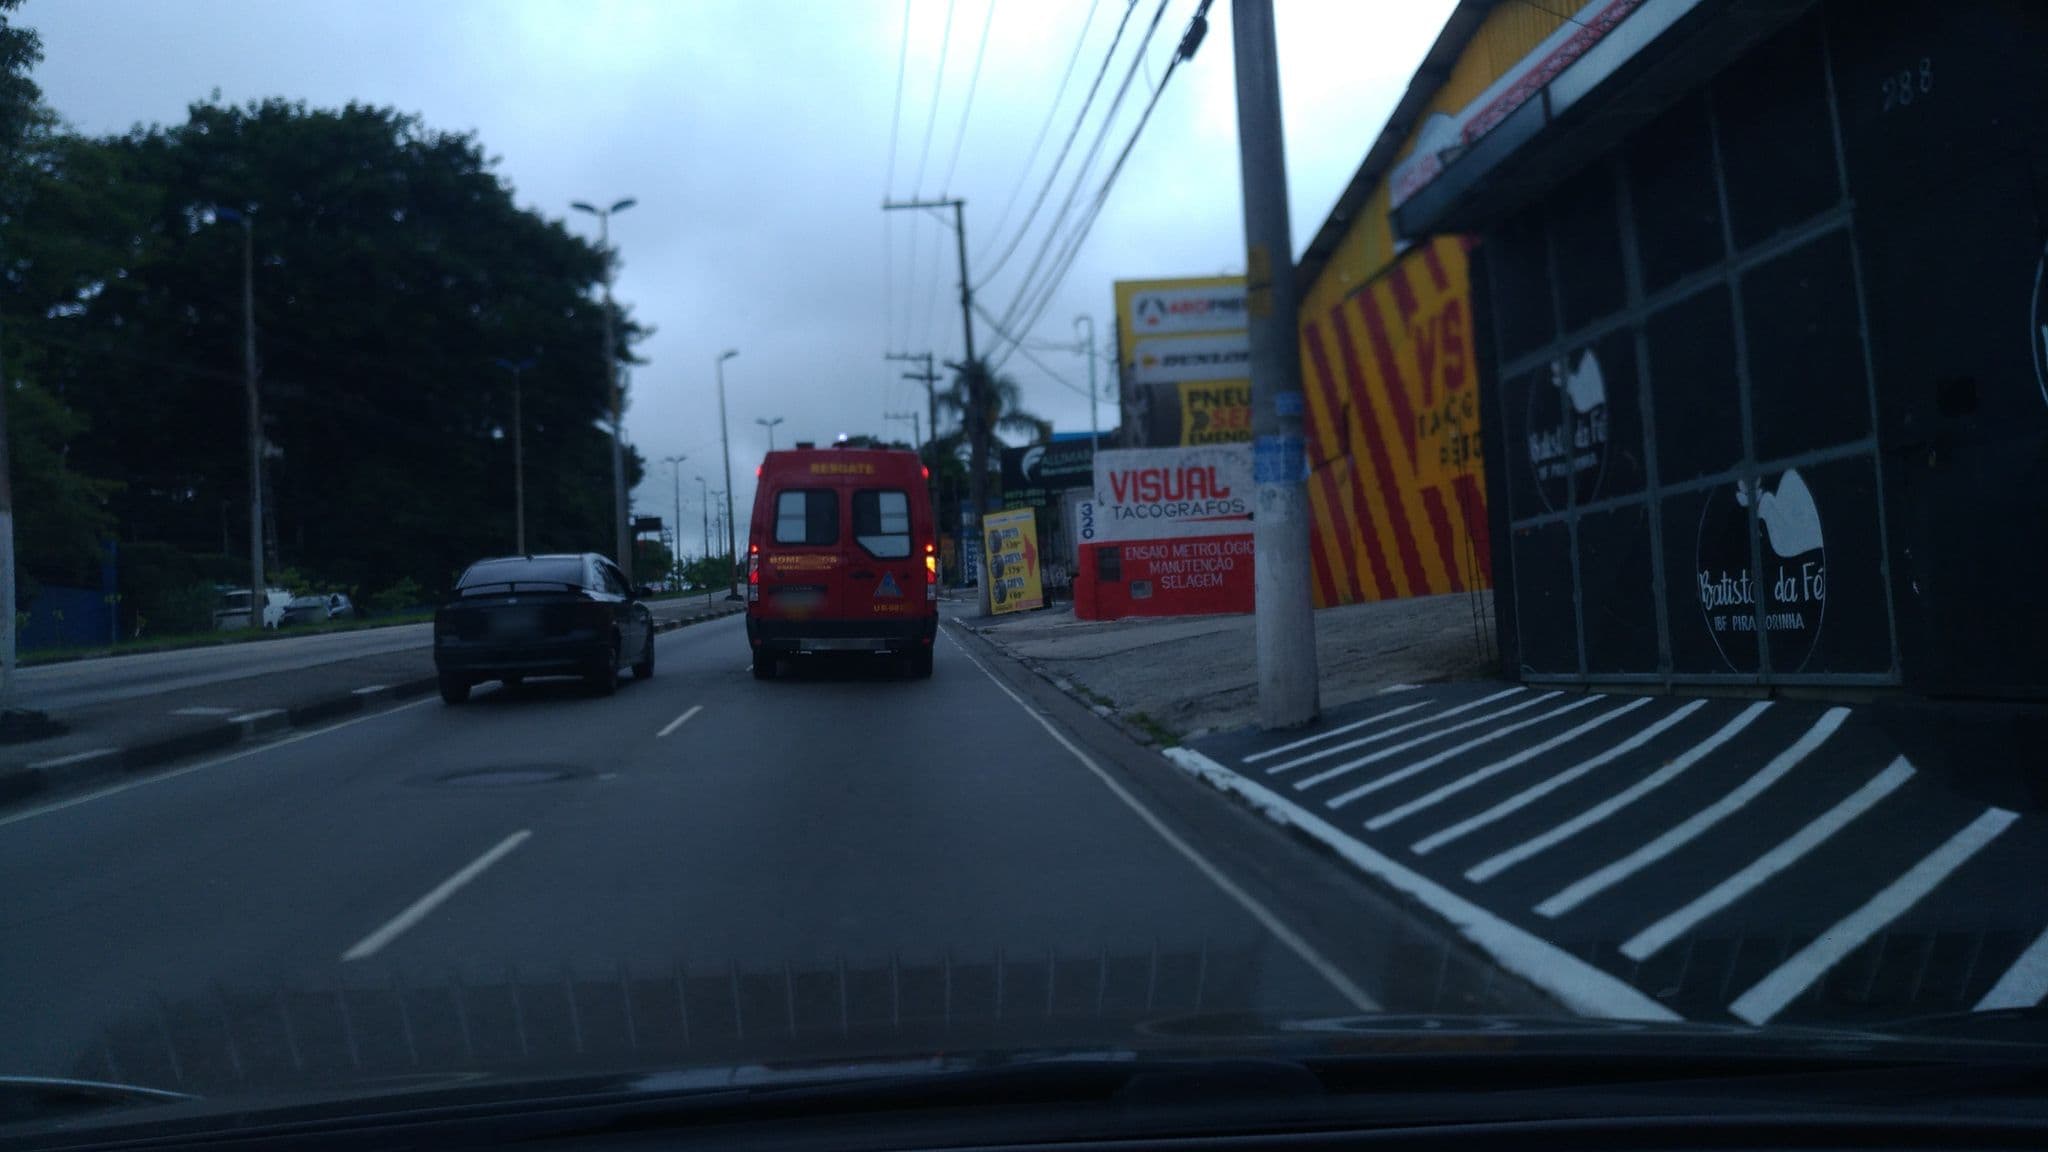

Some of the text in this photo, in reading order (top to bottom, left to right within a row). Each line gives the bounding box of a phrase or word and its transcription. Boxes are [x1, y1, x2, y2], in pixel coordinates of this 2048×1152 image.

[811, 463, 875, 475] RESGATE
[1110, 465, 1230, 504] VISUAL
[1112, 498, 1246, 521] TACOGRAFOS
[1081, 503, 1095, 540] 320
[1126, 545, 1169, 561] ENSAIO
[1160, 573, 1224, 590] SELAGEM
[1774, 565, 1799, 603] da
[1802, 561, 1824, 602] Fé
